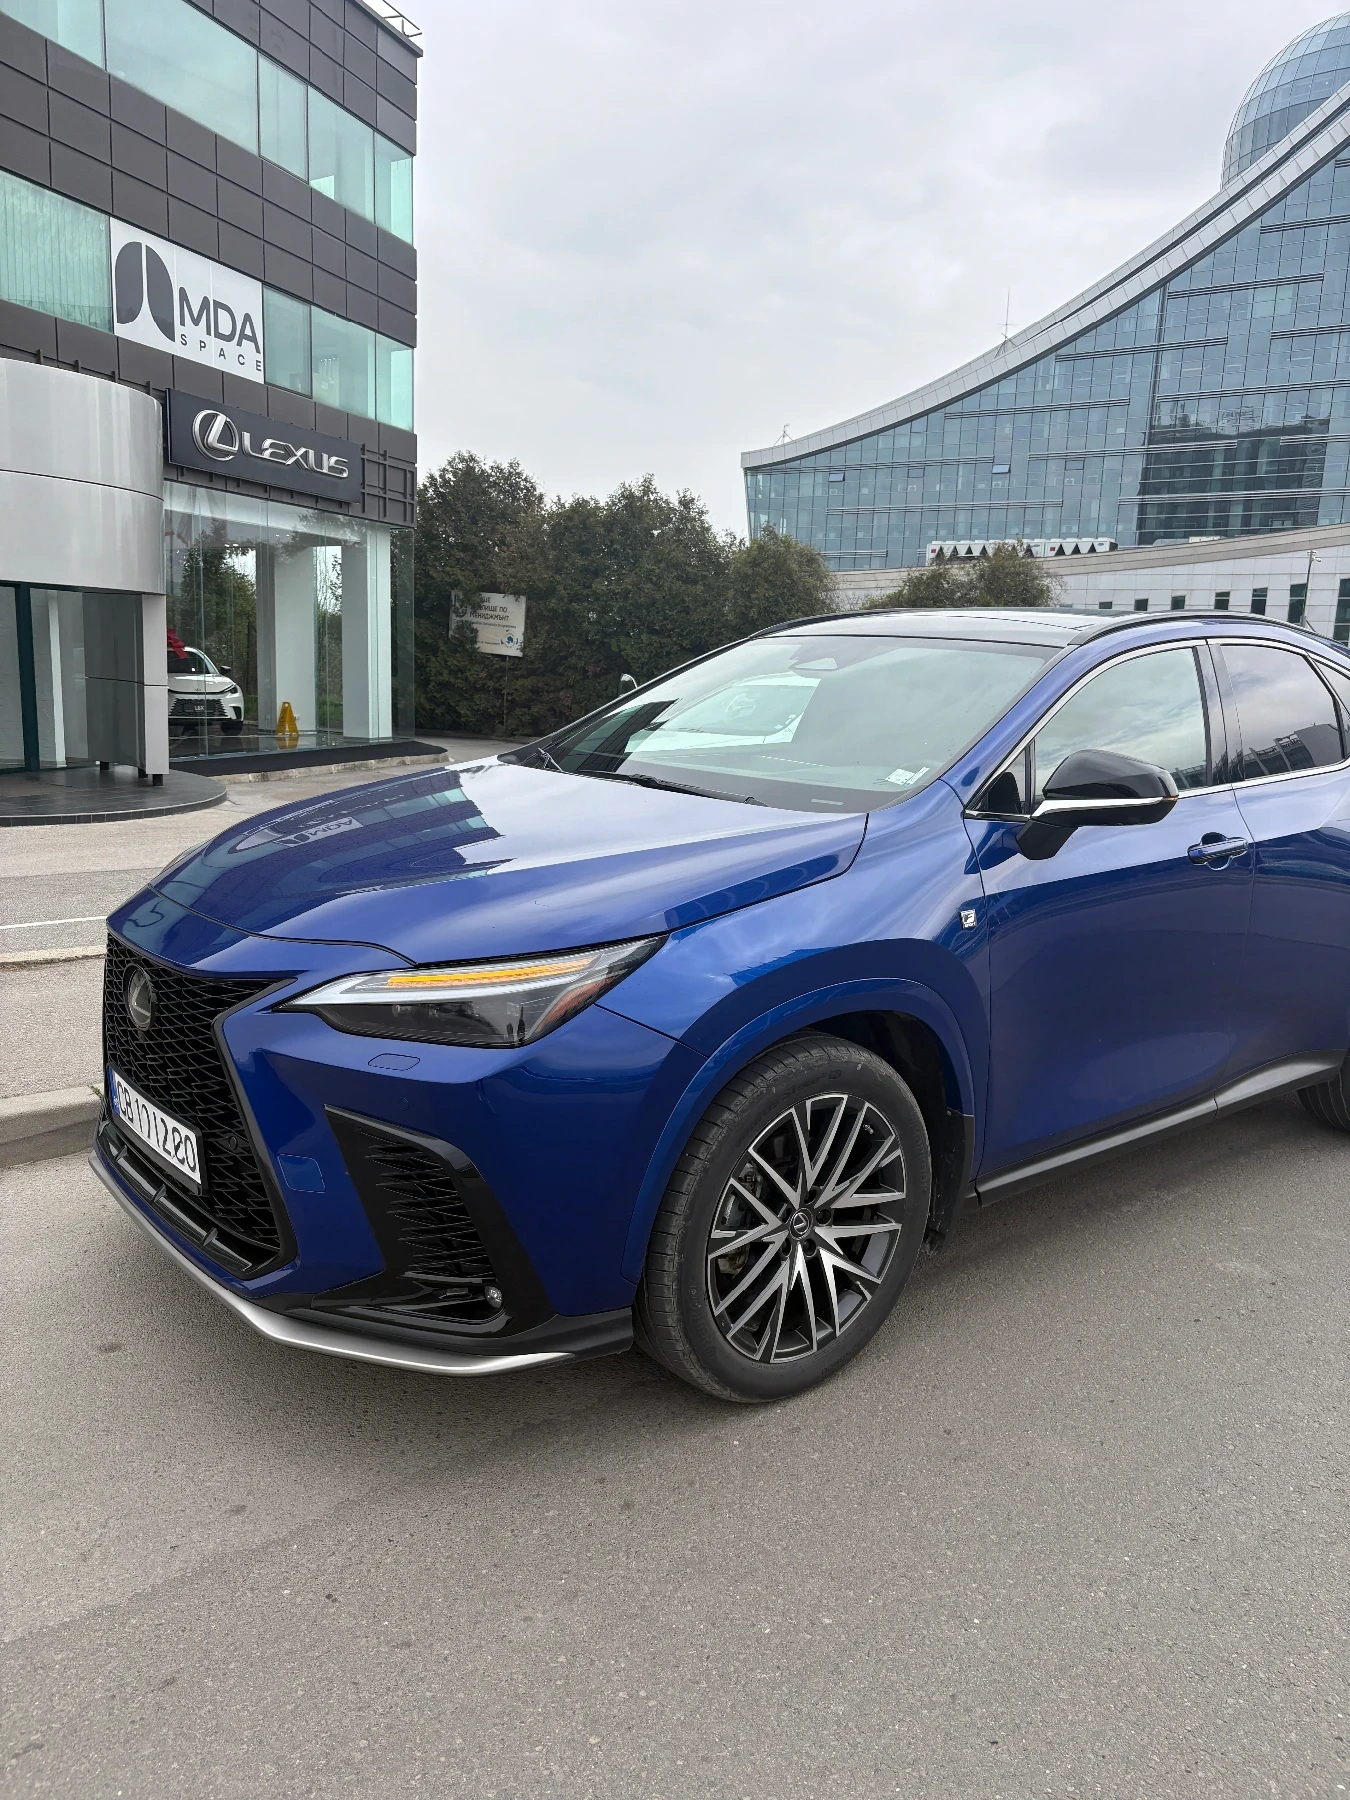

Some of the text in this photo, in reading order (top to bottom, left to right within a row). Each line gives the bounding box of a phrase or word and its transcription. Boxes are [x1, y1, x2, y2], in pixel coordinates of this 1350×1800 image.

[178, 286, 261, 355] MDA
[180, 333, 262, 371] SPACE
[242, 431, 349, 478] LEXUS
